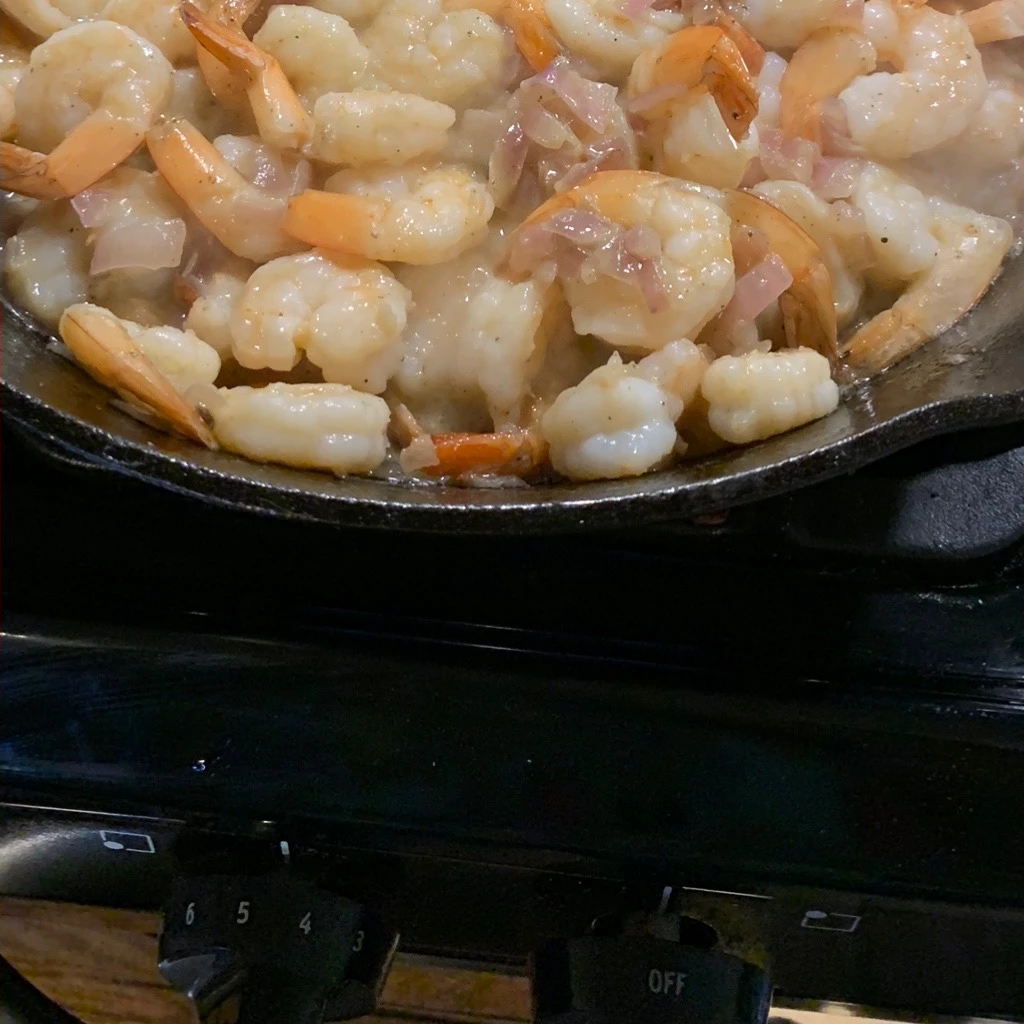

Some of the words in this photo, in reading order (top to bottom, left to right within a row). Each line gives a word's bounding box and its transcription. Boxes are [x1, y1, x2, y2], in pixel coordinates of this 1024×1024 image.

[184, 901, 196, 926] 6
[236, 900, 251, 925] 5
[298, 911, 313, 935] 4
[352, 929, 366, 953] 3
[648, 968, 687, 995] OFF
